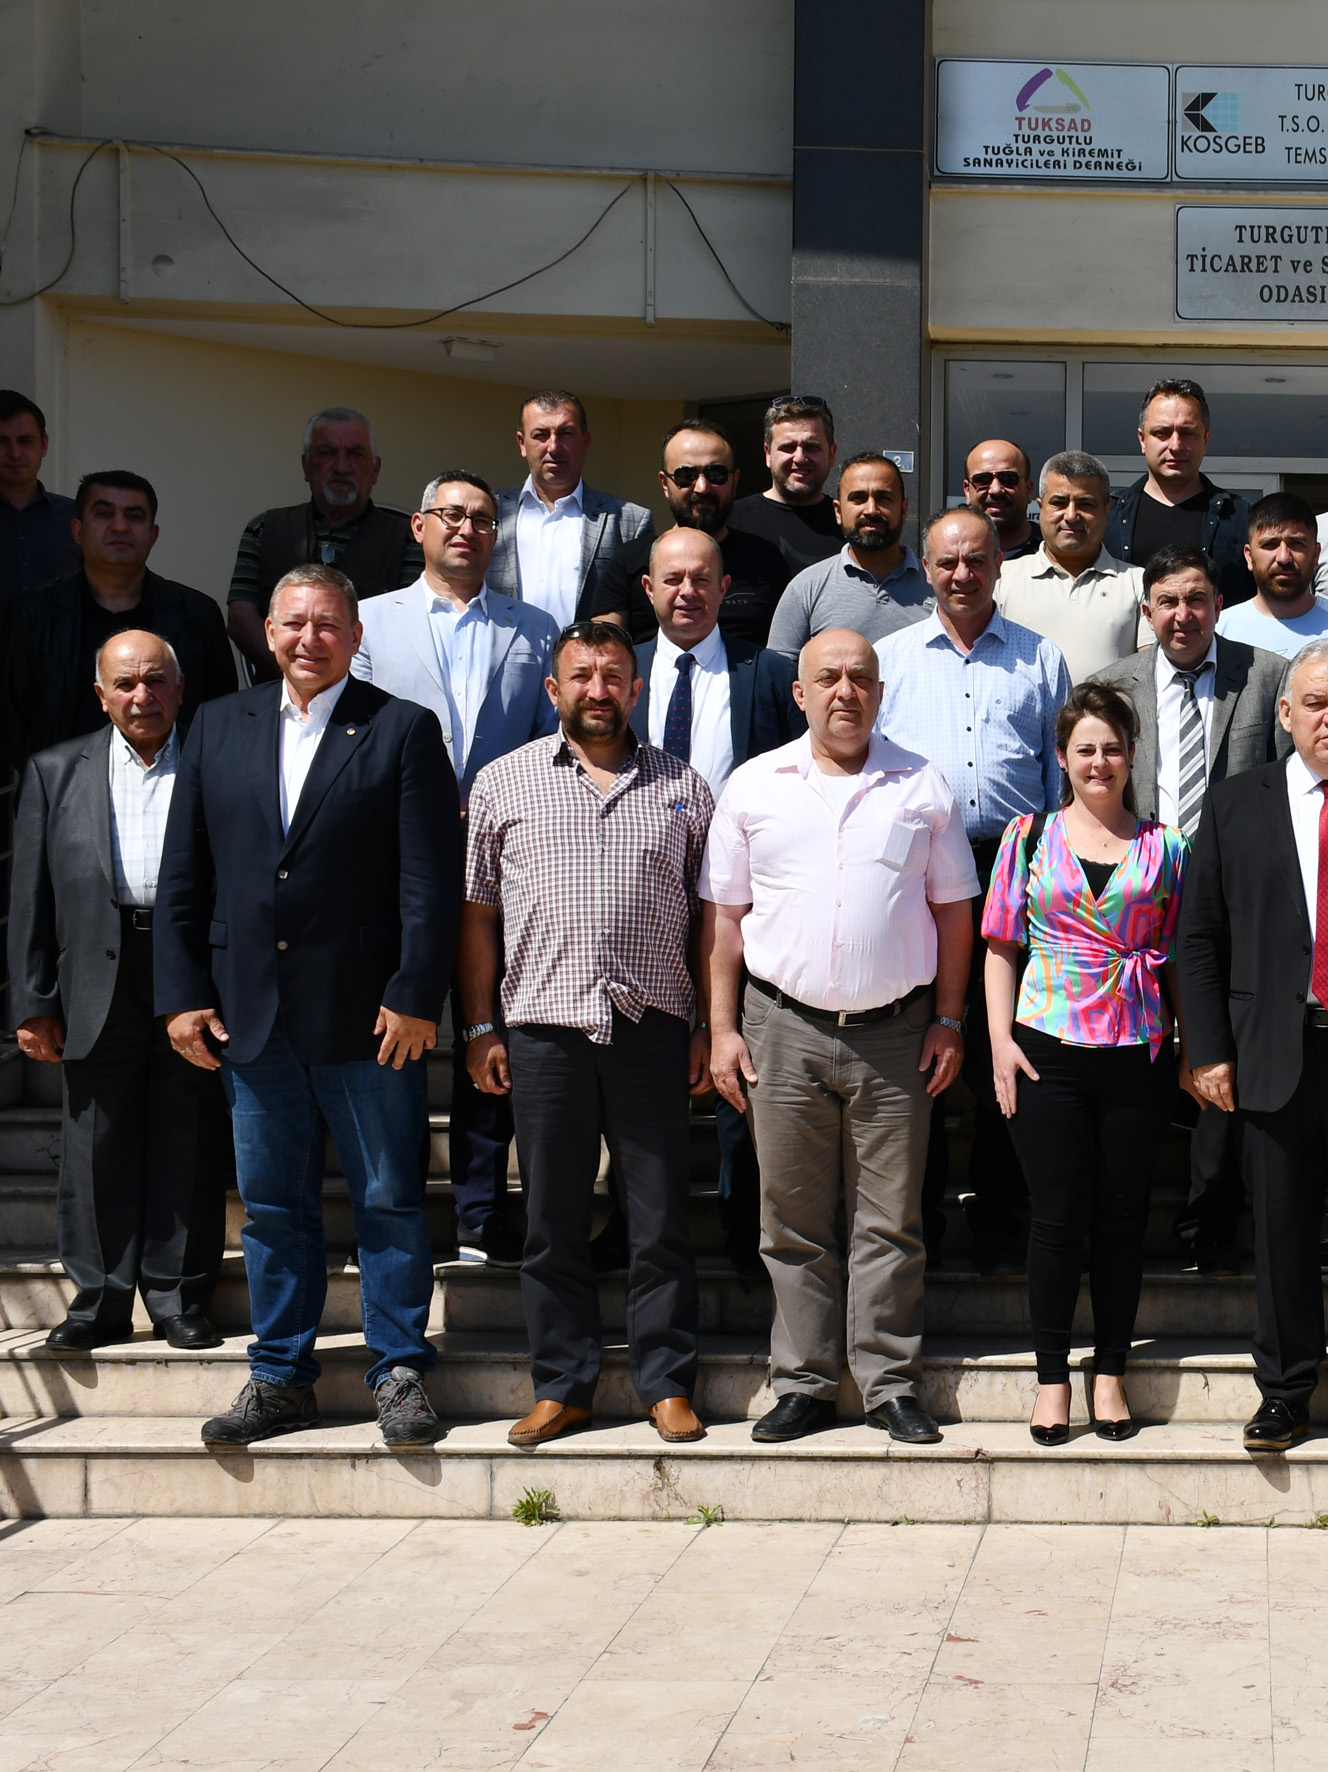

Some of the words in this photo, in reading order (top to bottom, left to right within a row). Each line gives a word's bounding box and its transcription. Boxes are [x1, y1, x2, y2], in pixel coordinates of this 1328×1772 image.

[1014, 116, 1092, 133] TUKSAD
[1278, 115, 1325, 133] T.S.O.
[1013, 134, 1093, 146] TURGUTLU
[1181, 135, 1266, 154] KOSGEB
[983, 143, 1033, 157] TUĞLA
[1186, 246, 1283, 274] TİCARET
[1289, 259, 1313, 274] ve
[1258, 284, 1327, 304] ODASI
